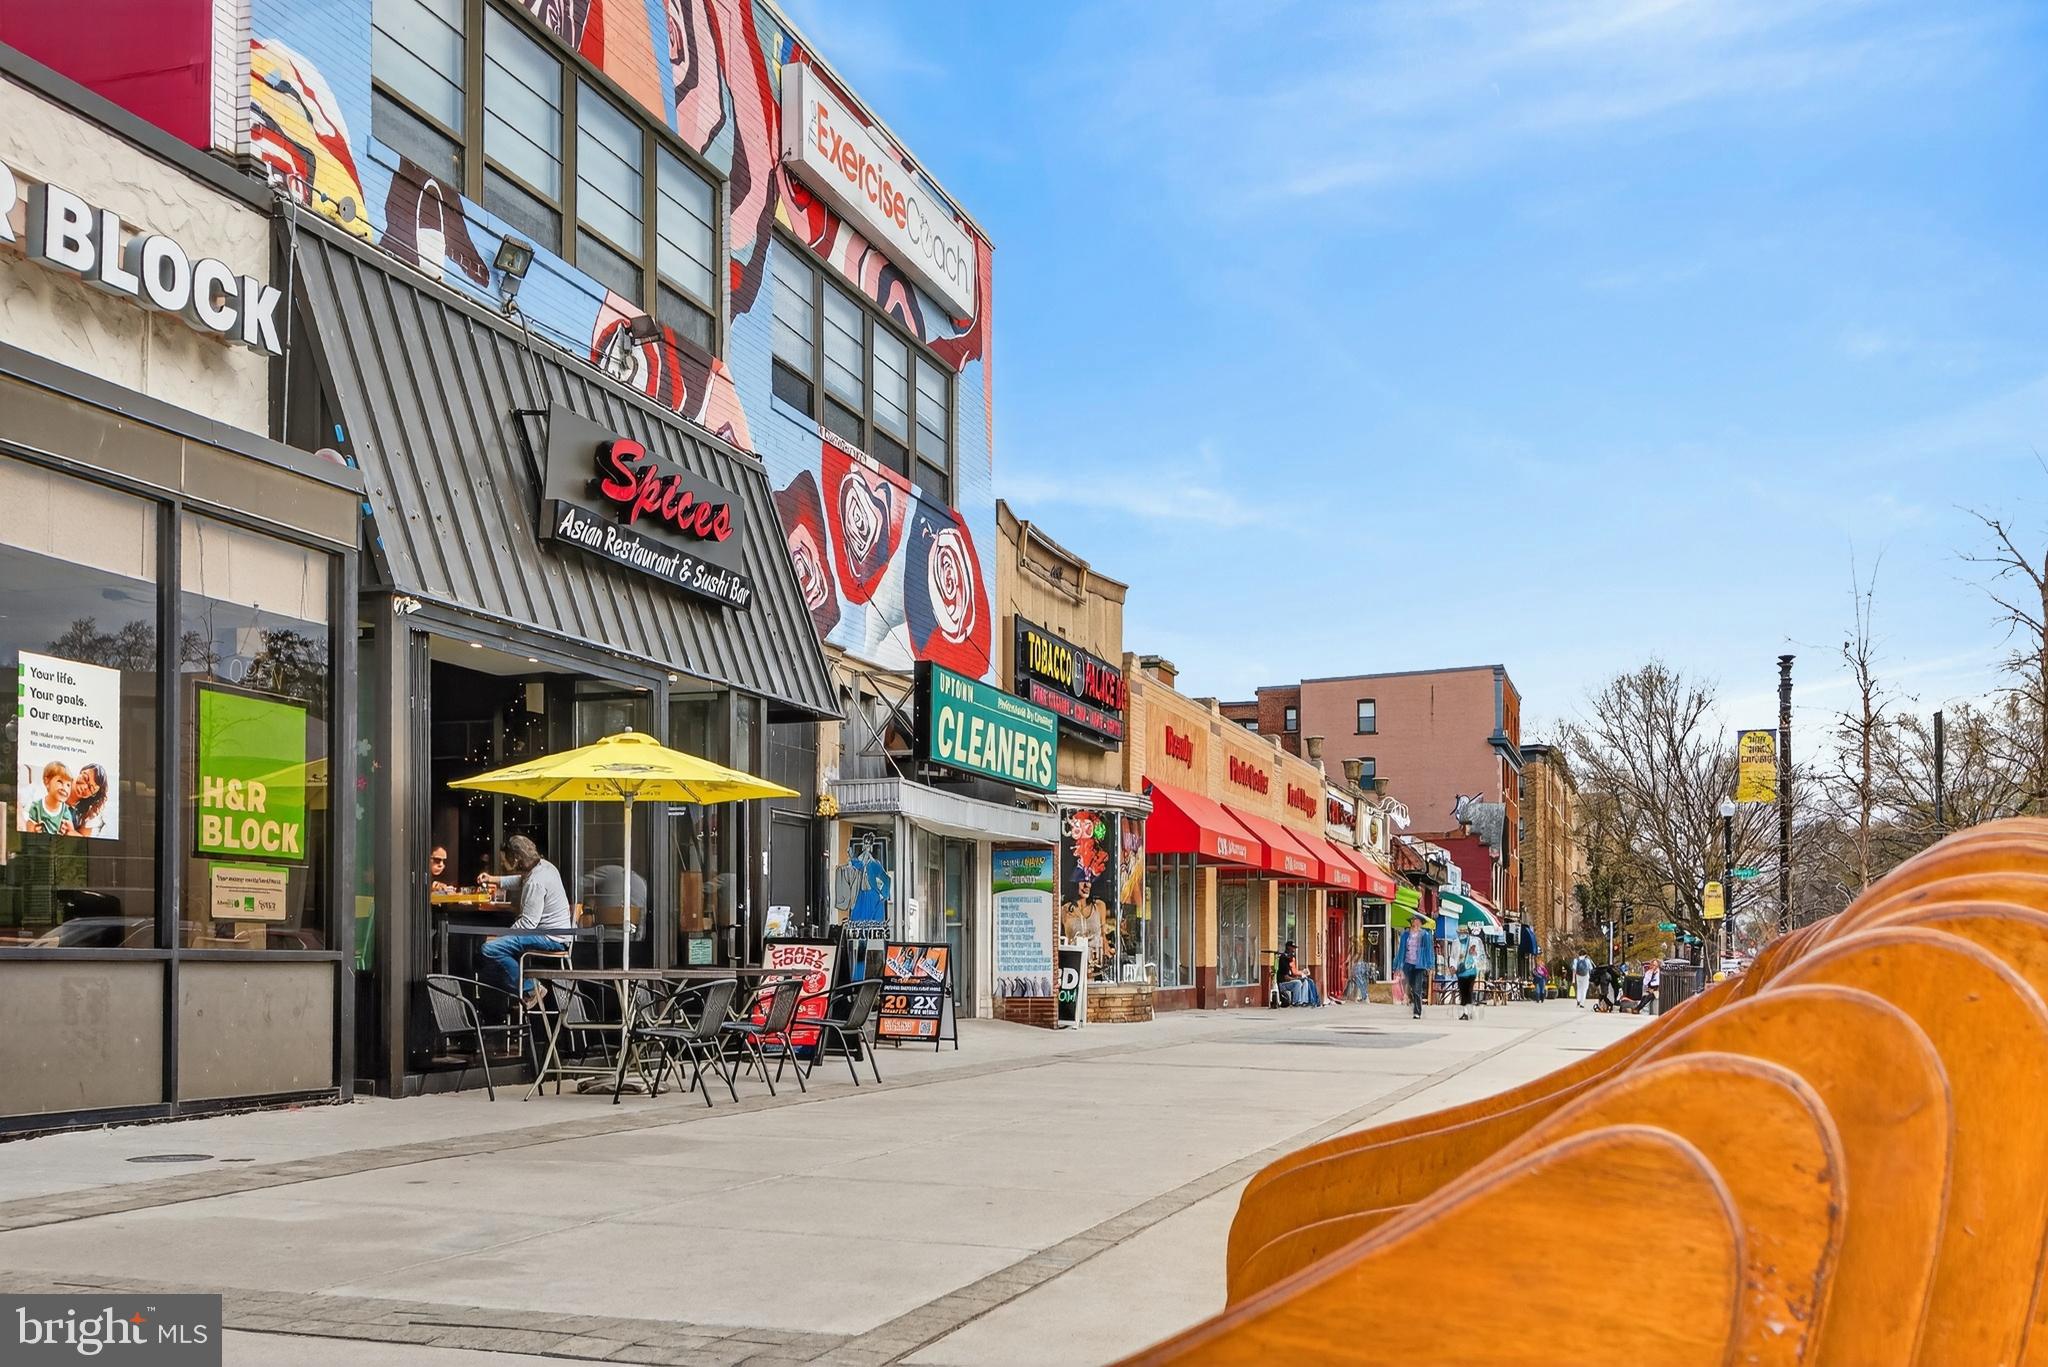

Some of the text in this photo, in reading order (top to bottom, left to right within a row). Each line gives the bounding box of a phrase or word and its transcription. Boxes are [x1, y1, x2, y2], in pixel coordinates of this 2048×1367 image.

[817, 101, 907, 230] Exercise
[45, 182, 283, 357] BLOCK
[600, 438, 734, 543] Spices
[558, 508, 750, 605] Asian Restaurant & Sushi Bar
[30, 666, 76, 686] Your life.
[1028, 631, 1073, 687] TOBACCO
[30, 686, 87, 707] Your goals.
[939, 672, 975, 704] UPTOWN
[1085, 658, 1115, 705] PALACE
[29, 706, 104, 729] Our expertise.
[937, 705, 1053, 788] CLEANERS
[202, 775, 267, 814] H&R
[202, 814, 300, 854] BLOCK
[772, 947, 829, 960] CRAZY
[772, 954, 824, 970] HOURS
[885, 995, 939, 1010] 20 2X
